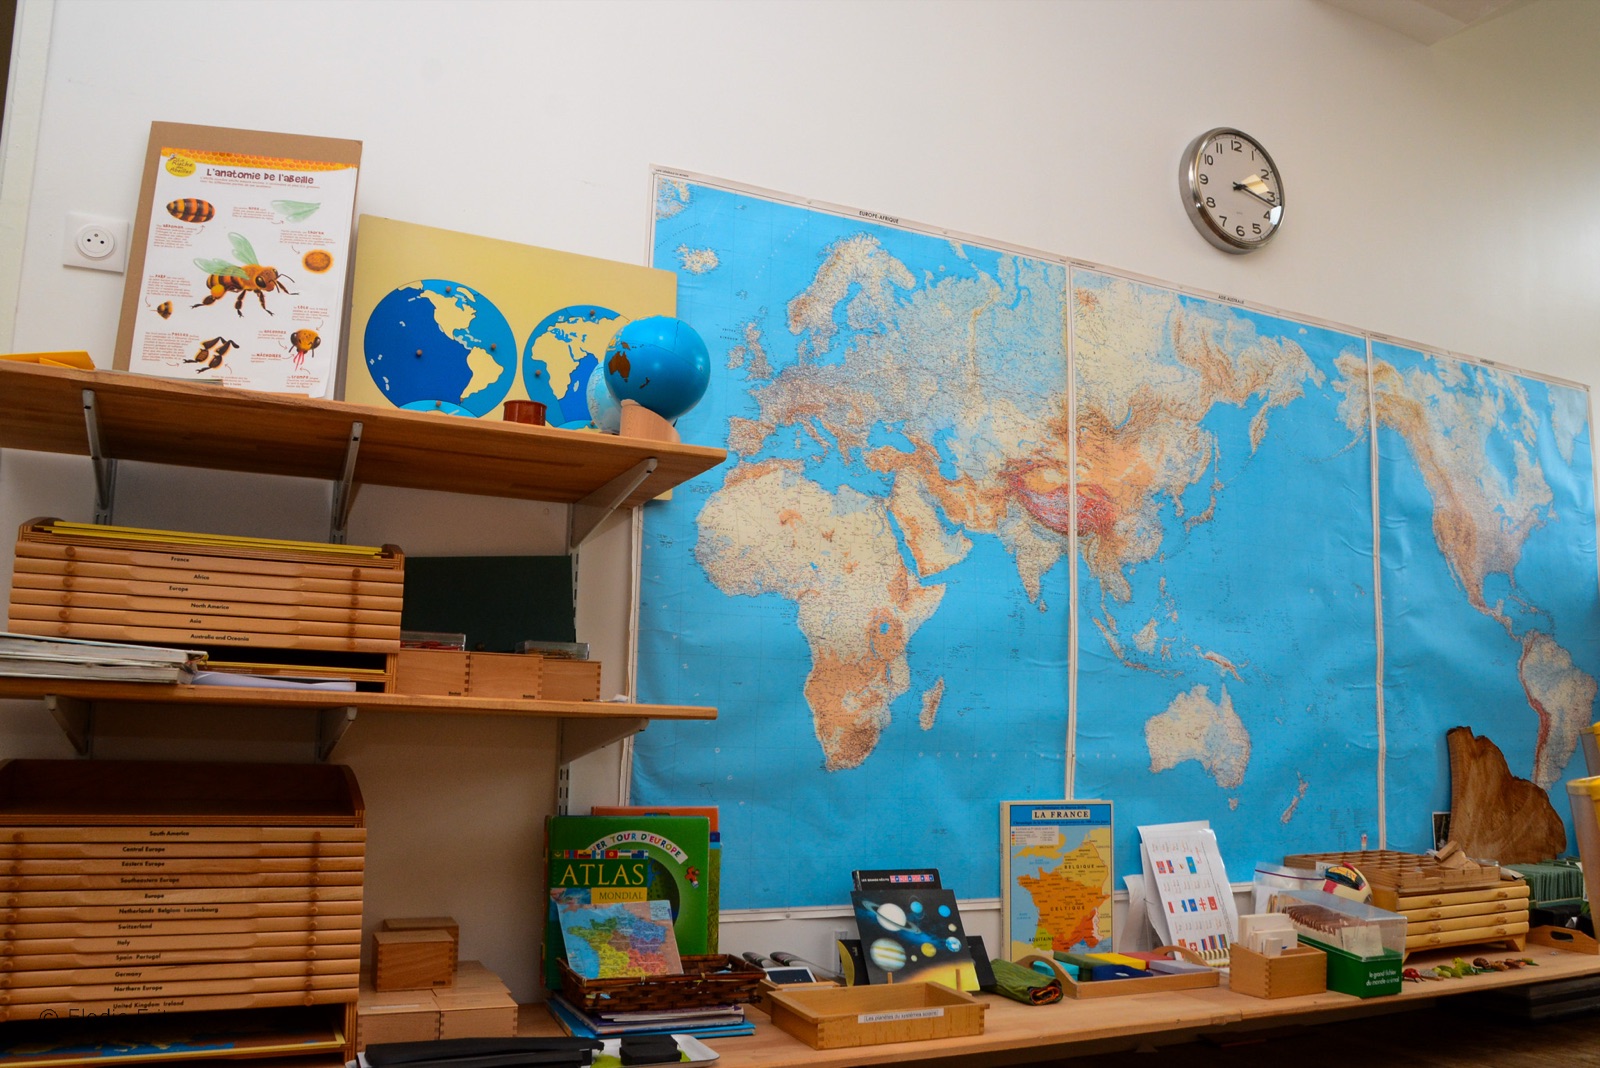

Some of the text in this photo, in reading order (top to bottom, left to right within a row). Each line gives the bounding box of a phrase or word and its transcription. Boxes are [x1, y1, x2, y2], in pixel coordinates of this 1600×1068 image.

[1215, 142, 1223, 155] 11
[1230, 139, 1243, 153] 12
[1203, 153, 1214, 166] 10
[206, 168, 261, 180] L'anatomie
[1199, 173, 1209, 185] 9
[1260, 169, 1270, 181] 2
[1205, 196, 1216, 209] 8
[1266, 191, 1276, 203] 3
[1218, 215, 1228, 227] 7
[1262, 210, 1271, 221] 4
[1235, 225, 1246, 237] 6
[1251, 223, 1262, 235] 5
[193, 573, 210, 581] Africa
[168, 585, 189, 593] Europe
[1034, 811, 1089, 819] LA FRANCE
[145, 846, 165, 854] Europe
[611, 833, 636, 843] TOUR
[640, 833, 681, 858] D'EUROPE
[560, 864, 644, 885] ATLAS
[159, 877, 180, 885] Europe
[599, 891, 643, 901] MONDIAL
[135, 952, 161, 961] Portugal
[114, 970, 143, 978] Germany
[113, 984, 163, 993] Northern Europe
[133, 1001, 160, 1009] Kingdom
